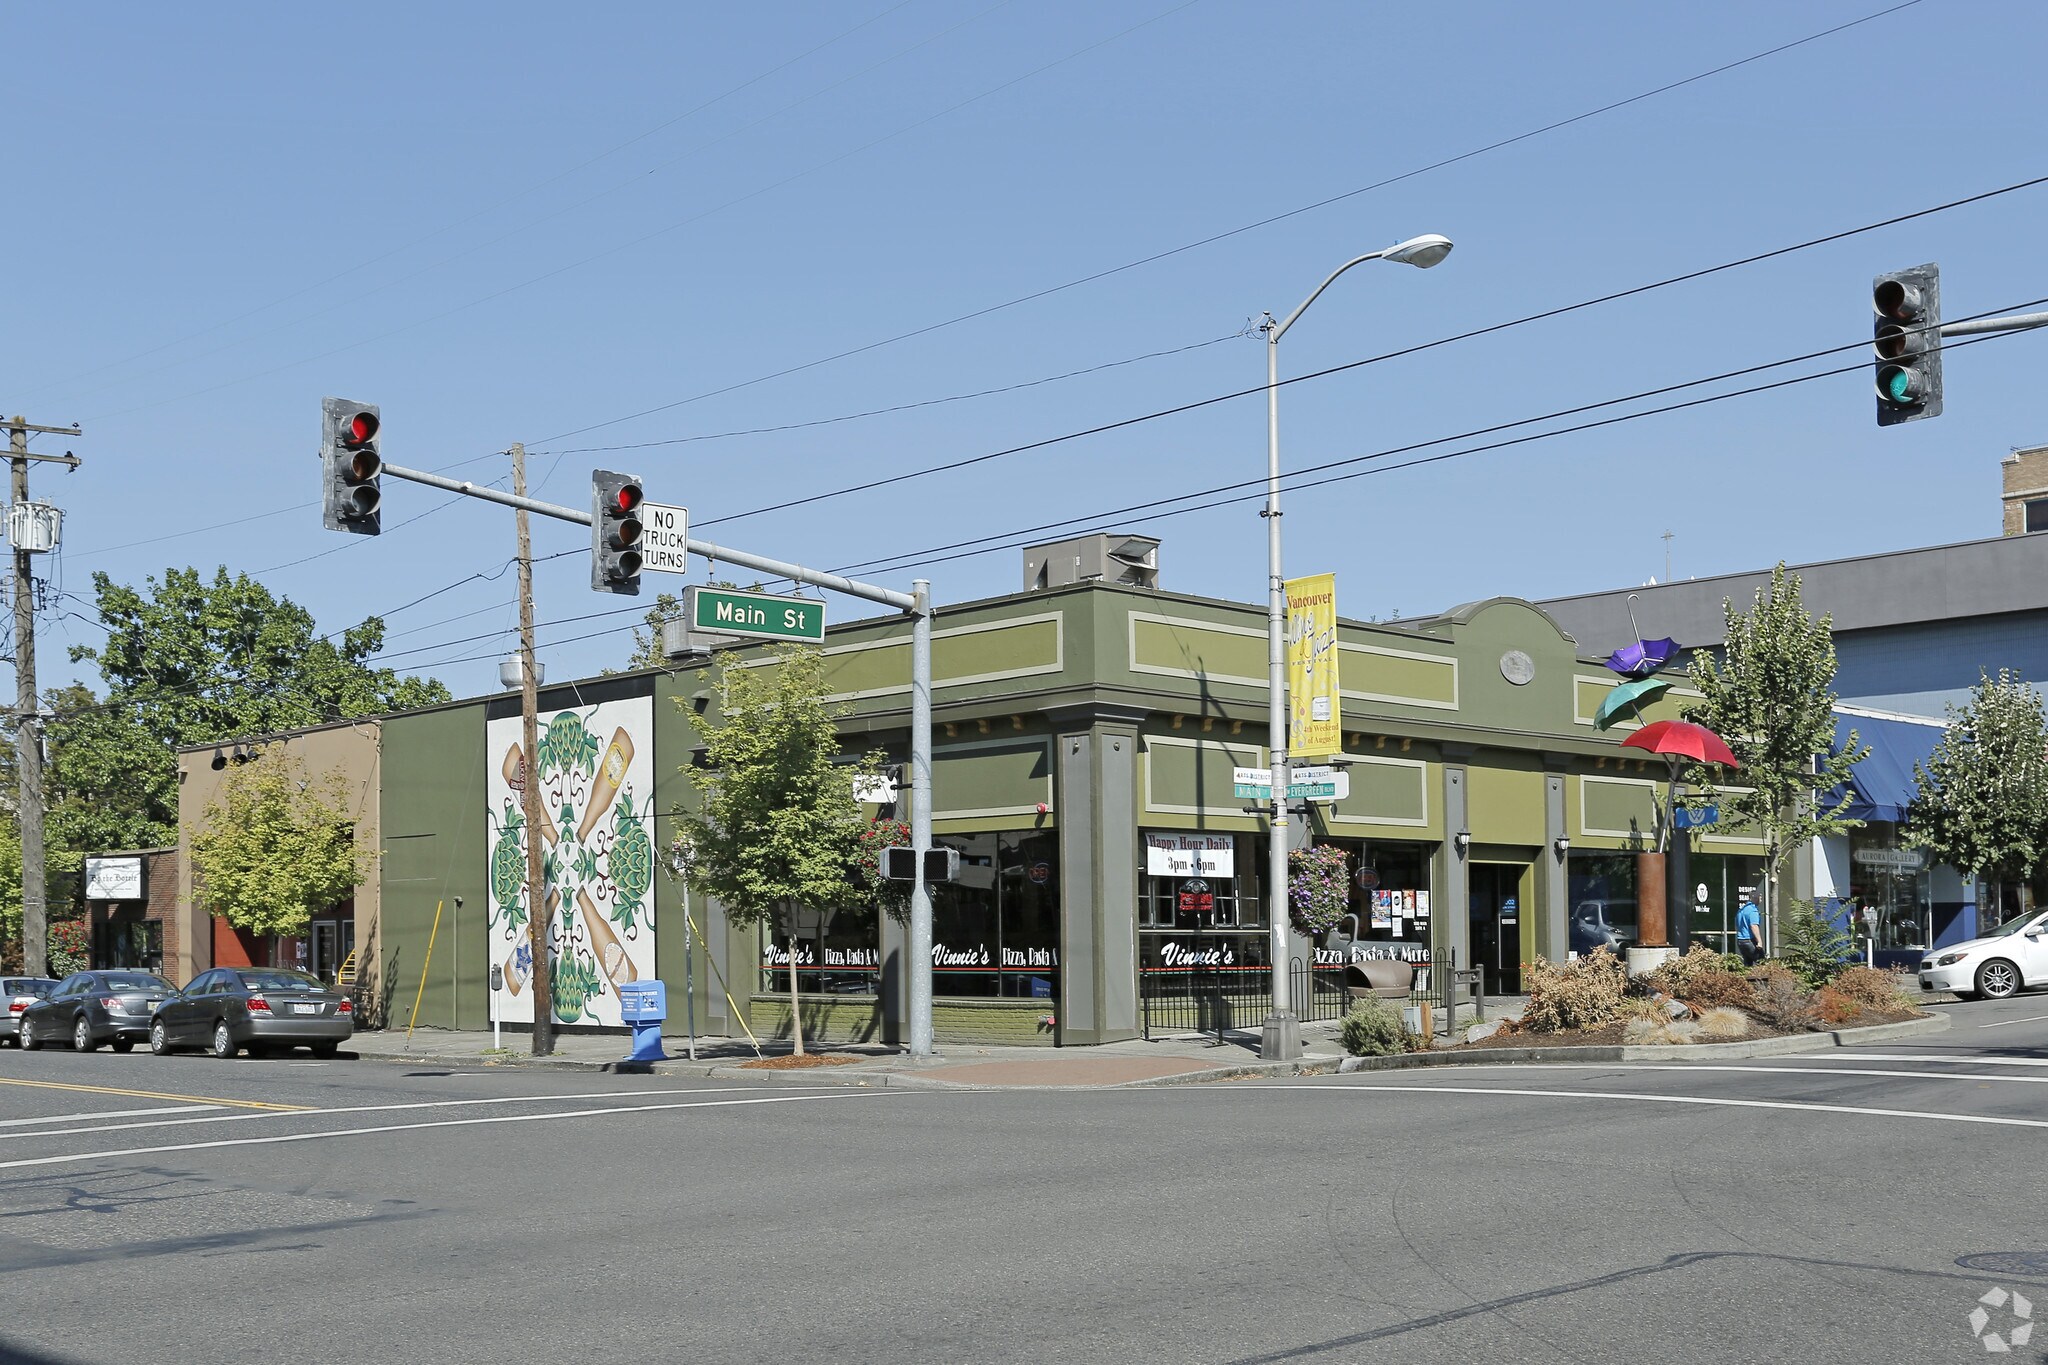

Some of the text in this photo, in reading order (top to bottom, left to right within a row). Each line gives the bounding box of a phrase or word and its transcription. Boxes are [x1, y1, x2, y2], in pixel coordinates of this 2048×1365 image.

[654, 510, 675, 529] NO
[643, 529, 684, 549] TRUCK
[643, 549, 684, 568] TURNS
[1286, 592, 1332, 610] Vancouver
[716, 600, 806, 630] Main St
[1312, 722, 1340, 733] Weekend
[1250, 772, 1271, 780] DISTRICT
[1307, 770, 1329, 778] DISTRICT
[1238, 786, 1261, 797] MAIN
[1291, 785, 1325, 797] EVERGREEN
[1147, 834, 1232, 855] Happy Hour Daily
[1167, 856, 1188, 874] 3pm
[1196, 857, 1216, 874] 6pm
[1861, 851, 1886, 861] AURORA
[764, 944, 815, 965] Vinie's
[824, 948, 845, 966] Pizza,
[846, 948, 865, 966] Pasta
[866, 949, 872, 966] &
[930, 942, 990, 966] Vinnie's
[1002, 947, 1025, 967] Pizza,
[1028, 947, 1050, 966] Pasta
[1160, 941, 1234, 967] Vinnie's
[1350, 945, 1384, 963] Pasta
[1386, 945, 1398, 961] &
